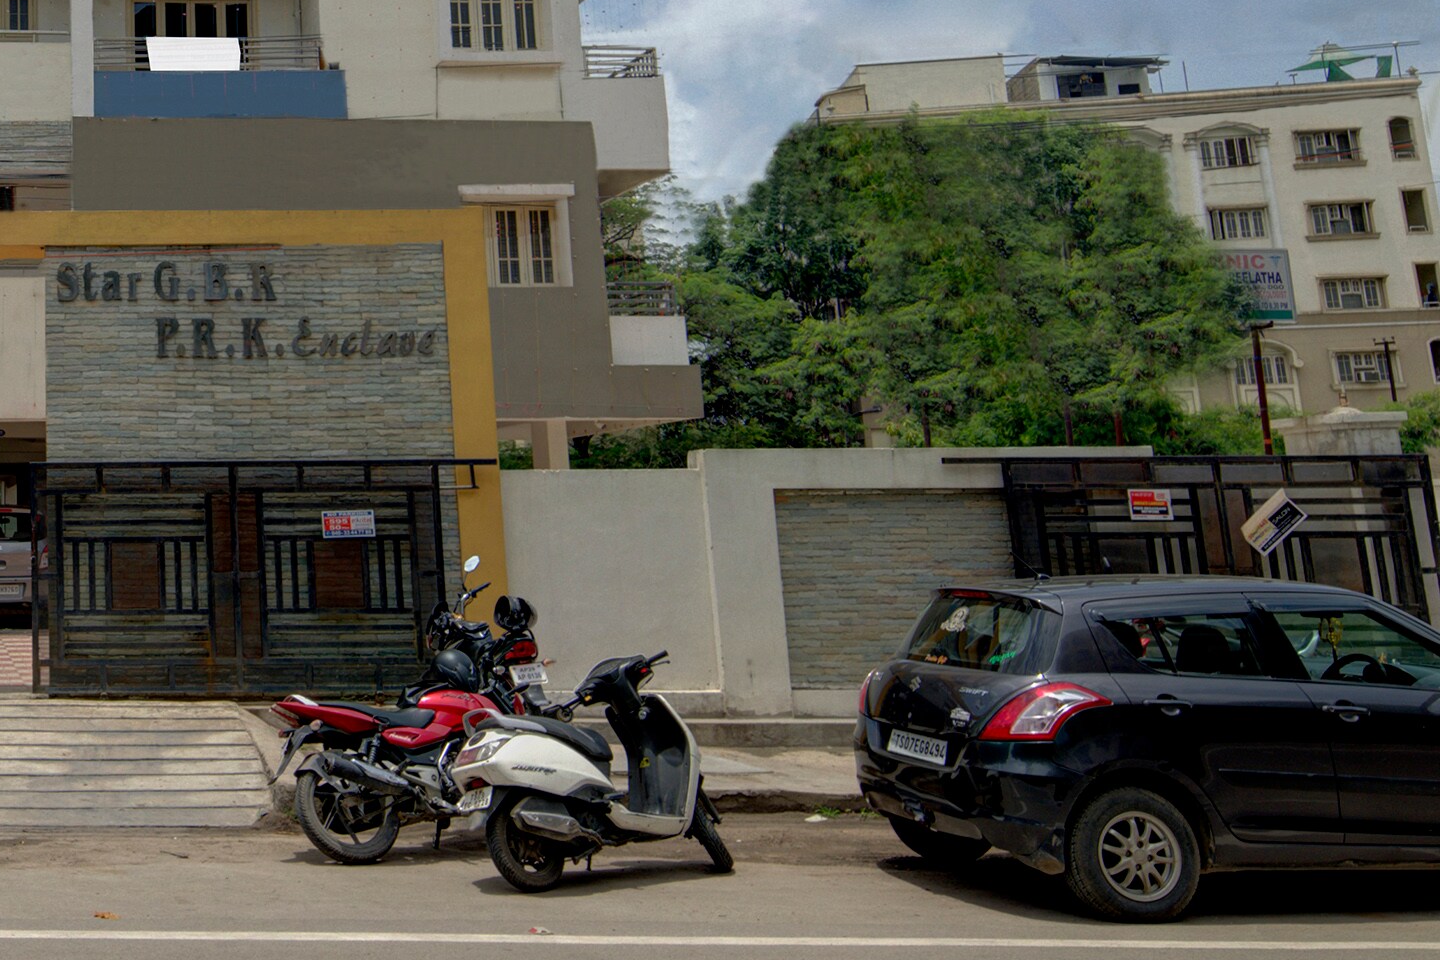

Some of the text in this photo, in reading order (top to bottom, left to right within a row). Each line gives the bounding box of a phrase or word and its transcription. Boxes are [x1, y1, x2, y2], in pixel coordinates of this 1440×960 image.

[57, 261, 277, 302] Star G.B.R
[291, 315, 438, 358] Enclave
[959, 686, 989, 696] SWIFT
[895, 734, 946, 758] TS07EG8494
